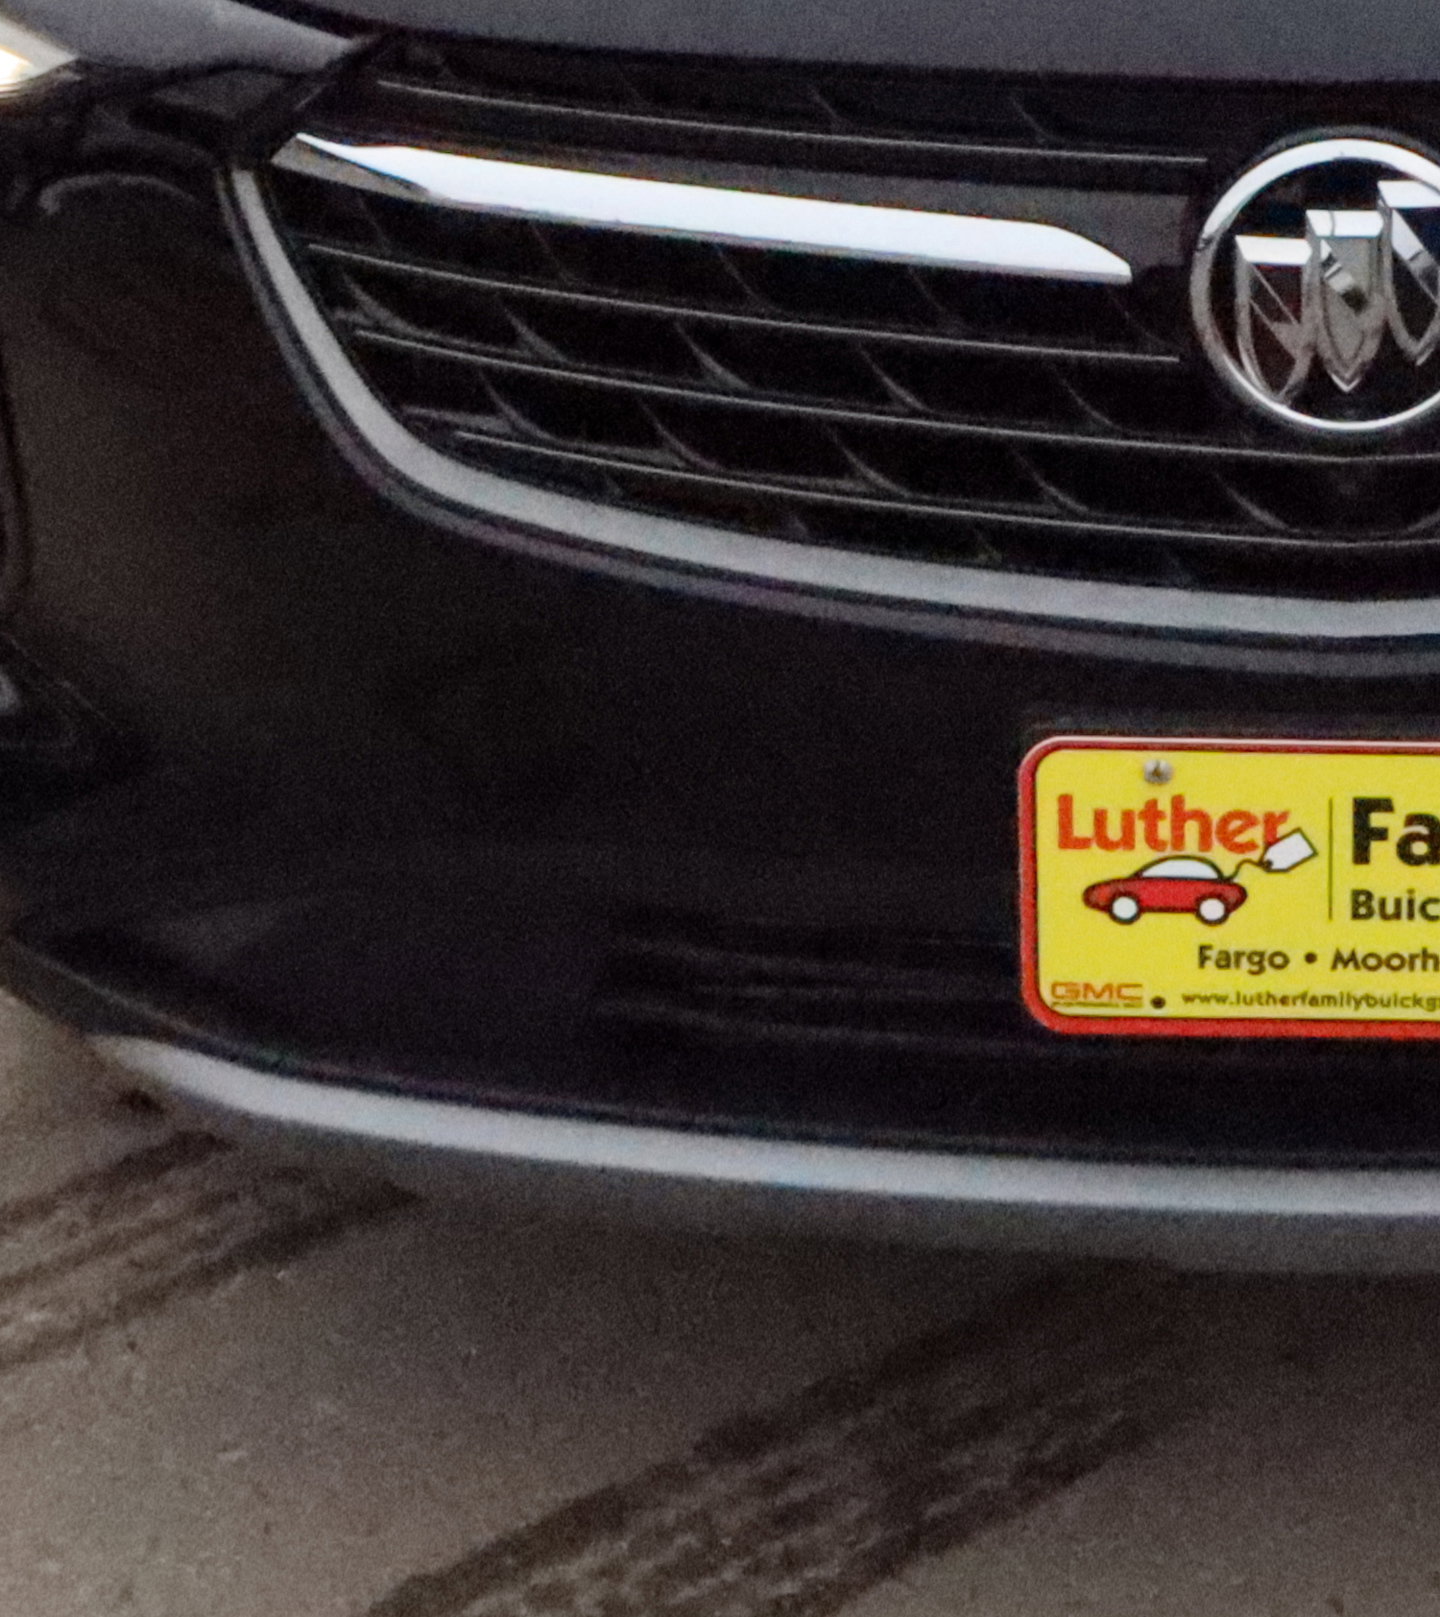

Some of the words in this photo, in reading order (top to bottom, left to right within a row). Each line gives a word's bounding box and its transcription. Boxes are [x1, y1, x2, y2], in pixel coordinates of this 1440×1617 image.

[1057, 794, 1290, 855] Luther
[1197, 945, 1290, 975] Fargo
[1051, 982, 1143, 1001] GMC
